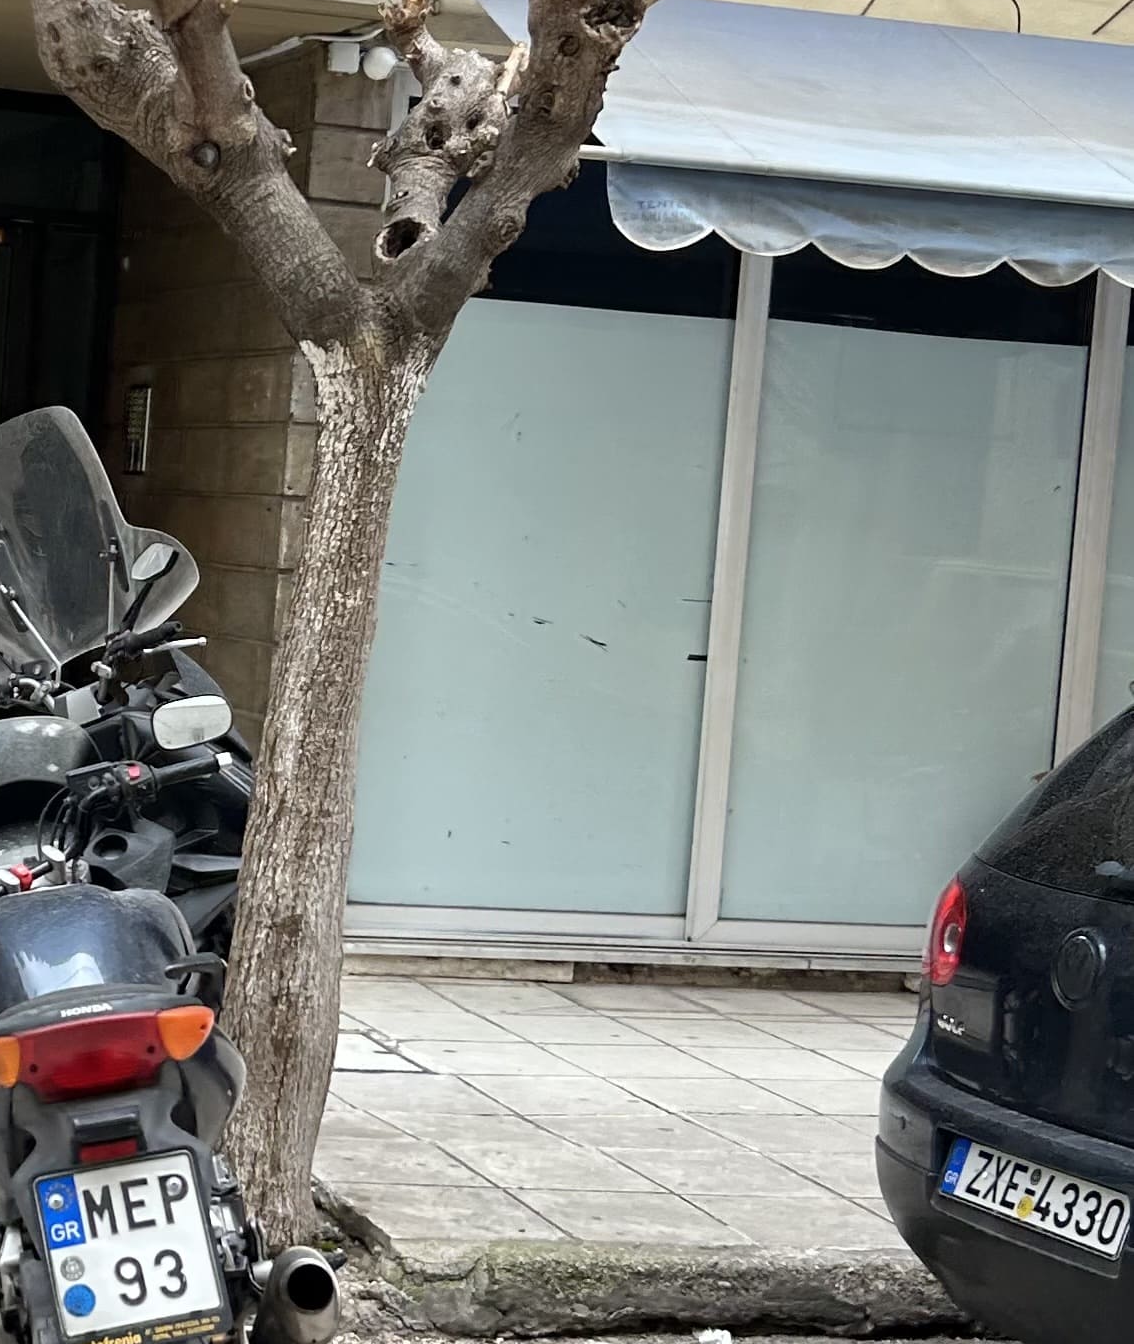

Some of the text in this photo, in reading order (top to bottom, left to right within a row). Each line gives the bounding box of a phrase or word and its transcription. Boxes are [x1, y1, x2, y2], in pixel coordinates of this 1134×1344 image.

[59, 1002, 114, 1018] HONDA
[82, 1173, 189, 1239] MEP
[965, 1149, 1125, 1246] ZXE-4330
[50, 1220, 81, 1243] GR
[114, 1248, 188, 1307] 93
